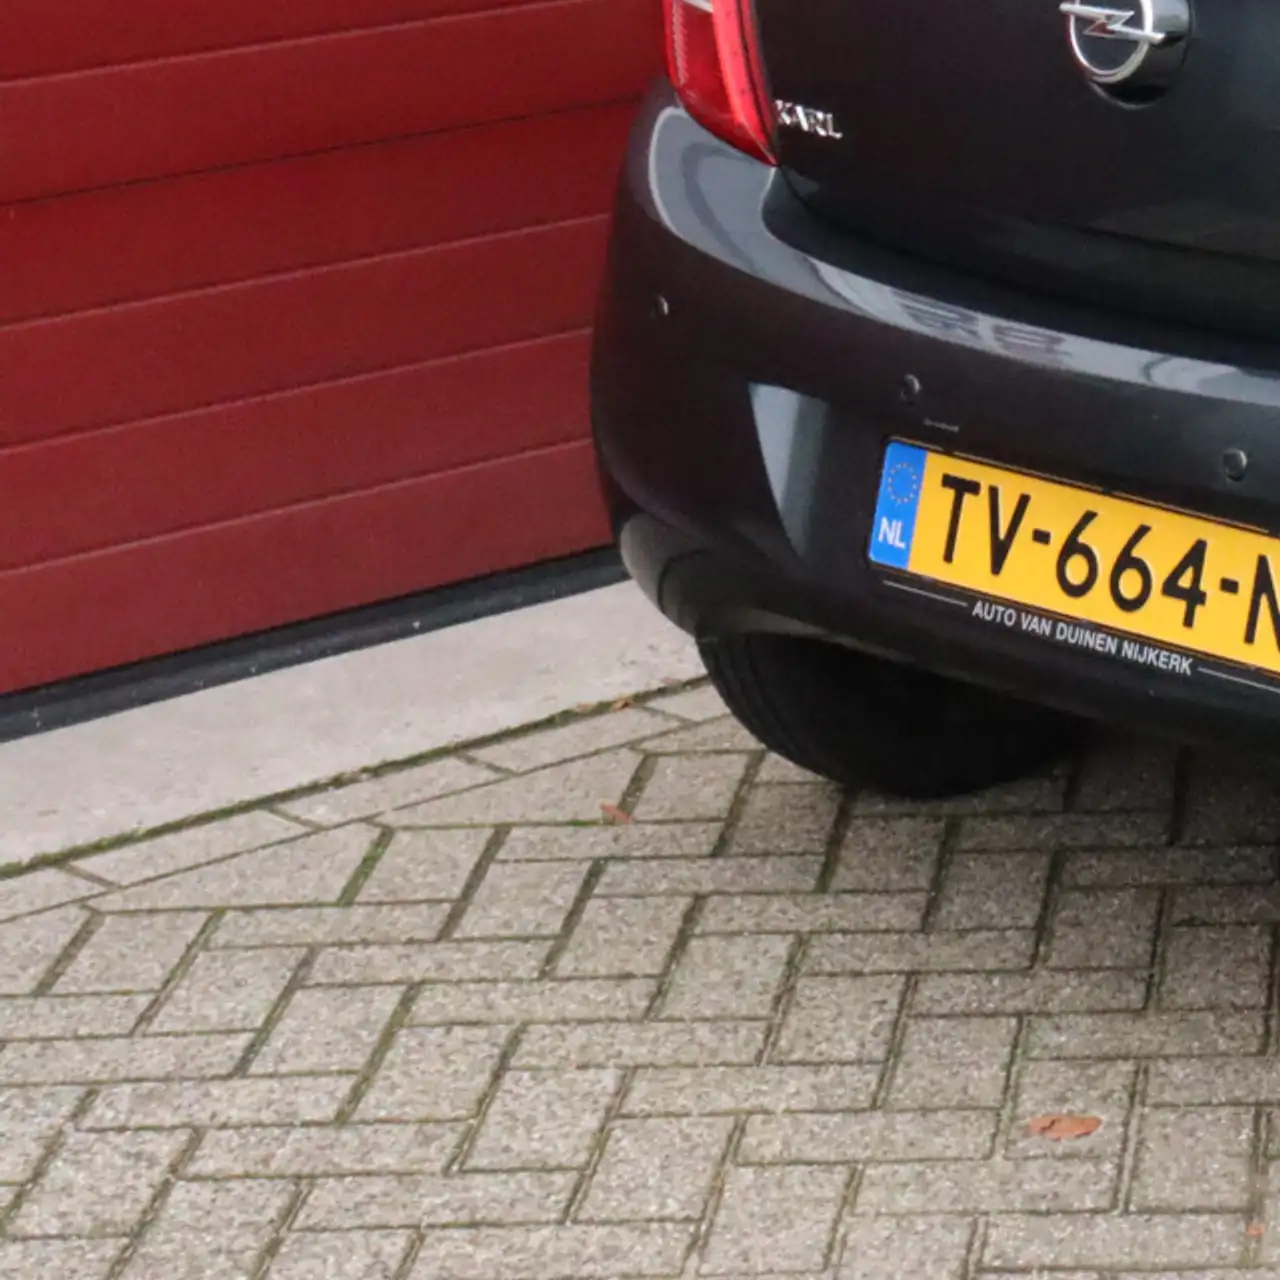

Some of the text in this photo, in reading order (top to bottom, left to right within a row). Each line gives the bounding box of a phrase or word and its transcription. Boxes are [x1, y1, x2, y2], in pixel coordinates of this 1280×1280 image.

[775, 99, 842, 139] KARL
[878, 517, 906, 549] NL
[972, 600, 1193, 676] AUTO VAN DUINEN NIJKERK
